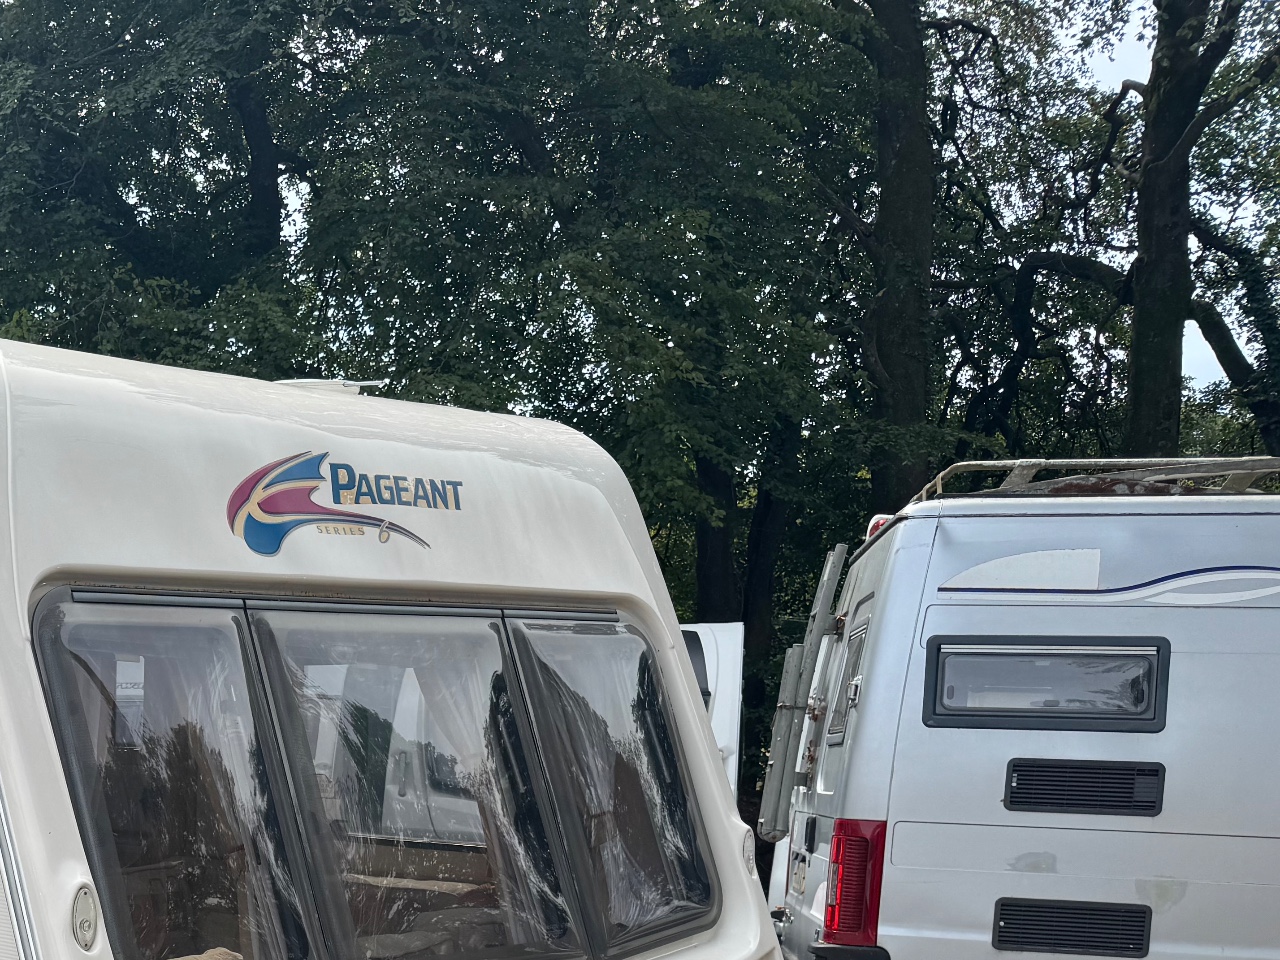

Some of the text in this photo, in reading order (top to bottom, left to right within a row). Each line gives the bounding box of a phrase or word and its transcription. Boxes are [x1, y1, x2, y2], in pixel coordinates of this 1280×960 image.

[328, 462, 464, 511] PAGEANT
[316, 520, 391, 544] SERIES 6
